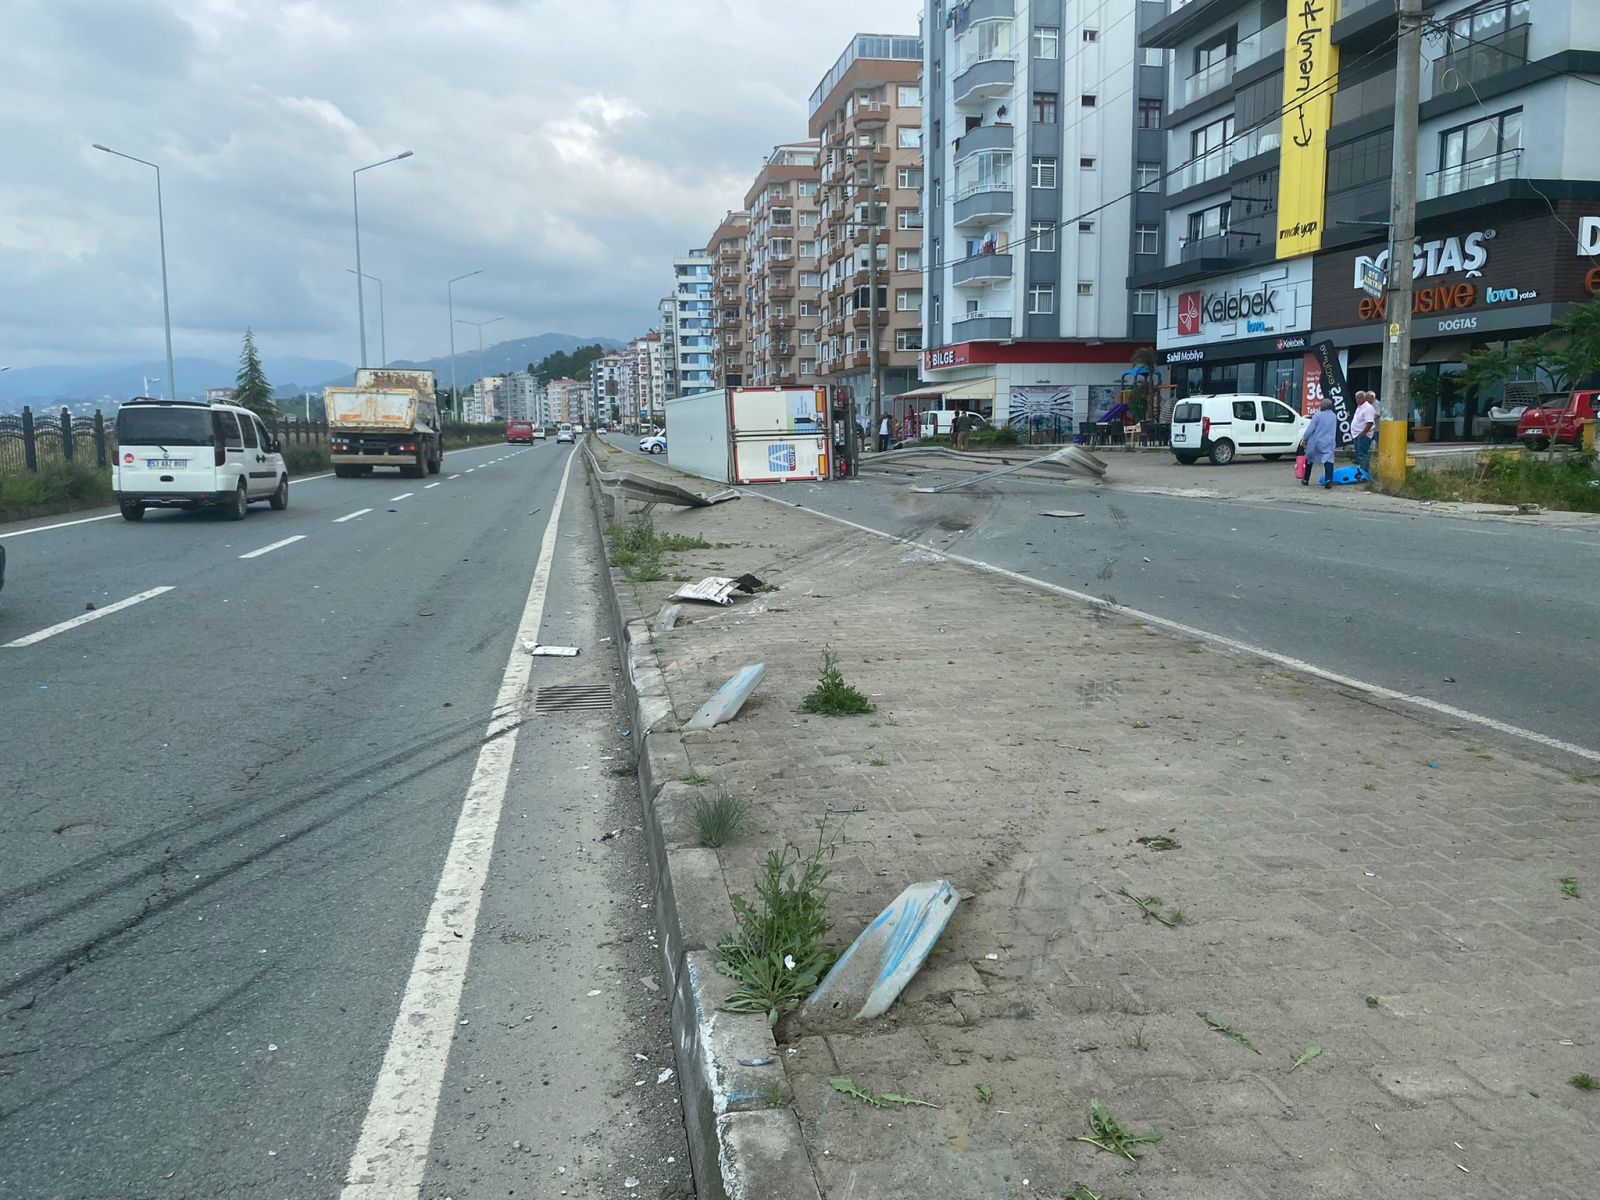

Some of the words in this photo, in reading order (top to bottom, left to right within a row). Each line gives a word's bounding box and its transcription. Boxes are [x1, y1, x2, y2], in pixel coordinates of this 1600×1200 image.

[1201, 284, 1276, 324] Kelebek
[1358, 280, 1475, 320] exusive
[1283, 338, 1305, 348] Kelebek
